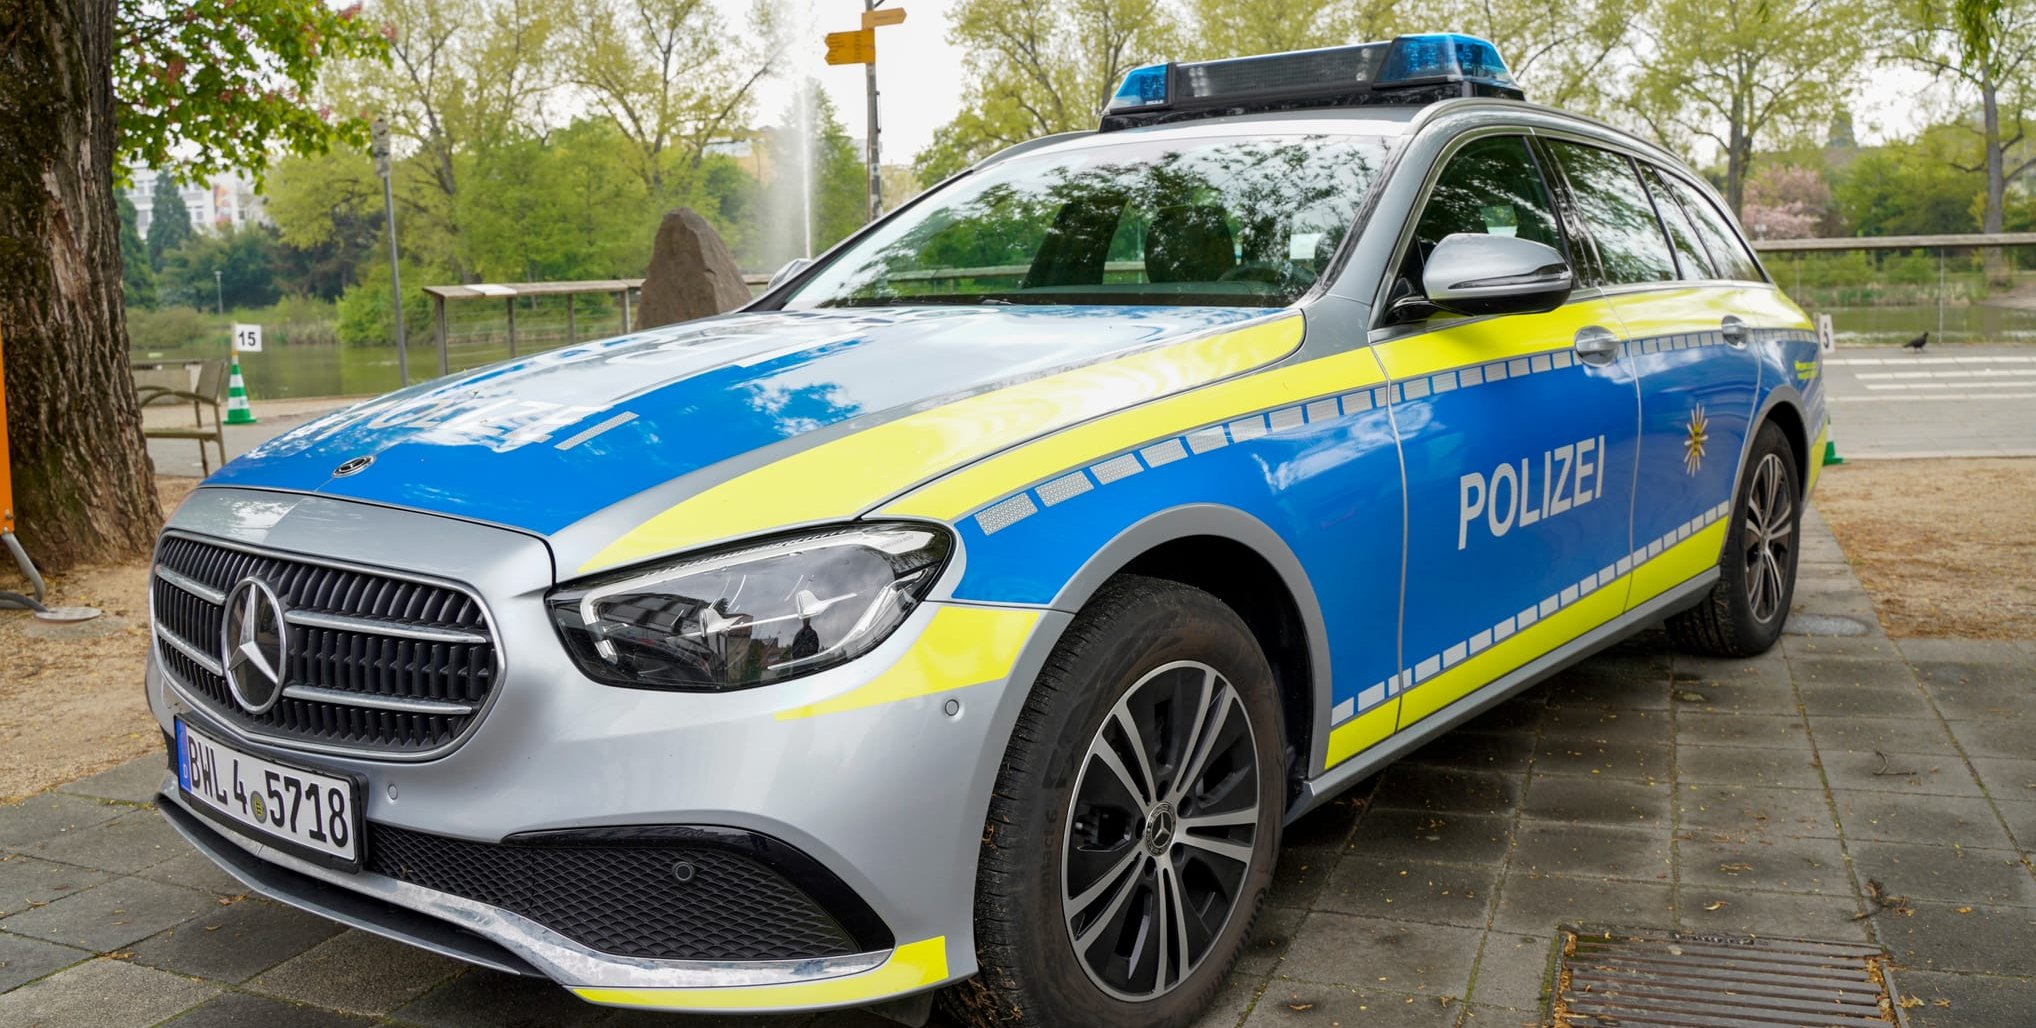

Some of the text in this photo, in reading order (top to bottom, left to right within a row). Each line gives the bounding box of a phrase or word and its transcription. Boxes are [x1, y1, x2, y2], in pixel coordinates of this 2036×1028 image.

[238, 331, 256, 347] 15
[1458, 434, 1605, 551] POLIZEI
[188, 735, 349, 848] BWL 4 5718
